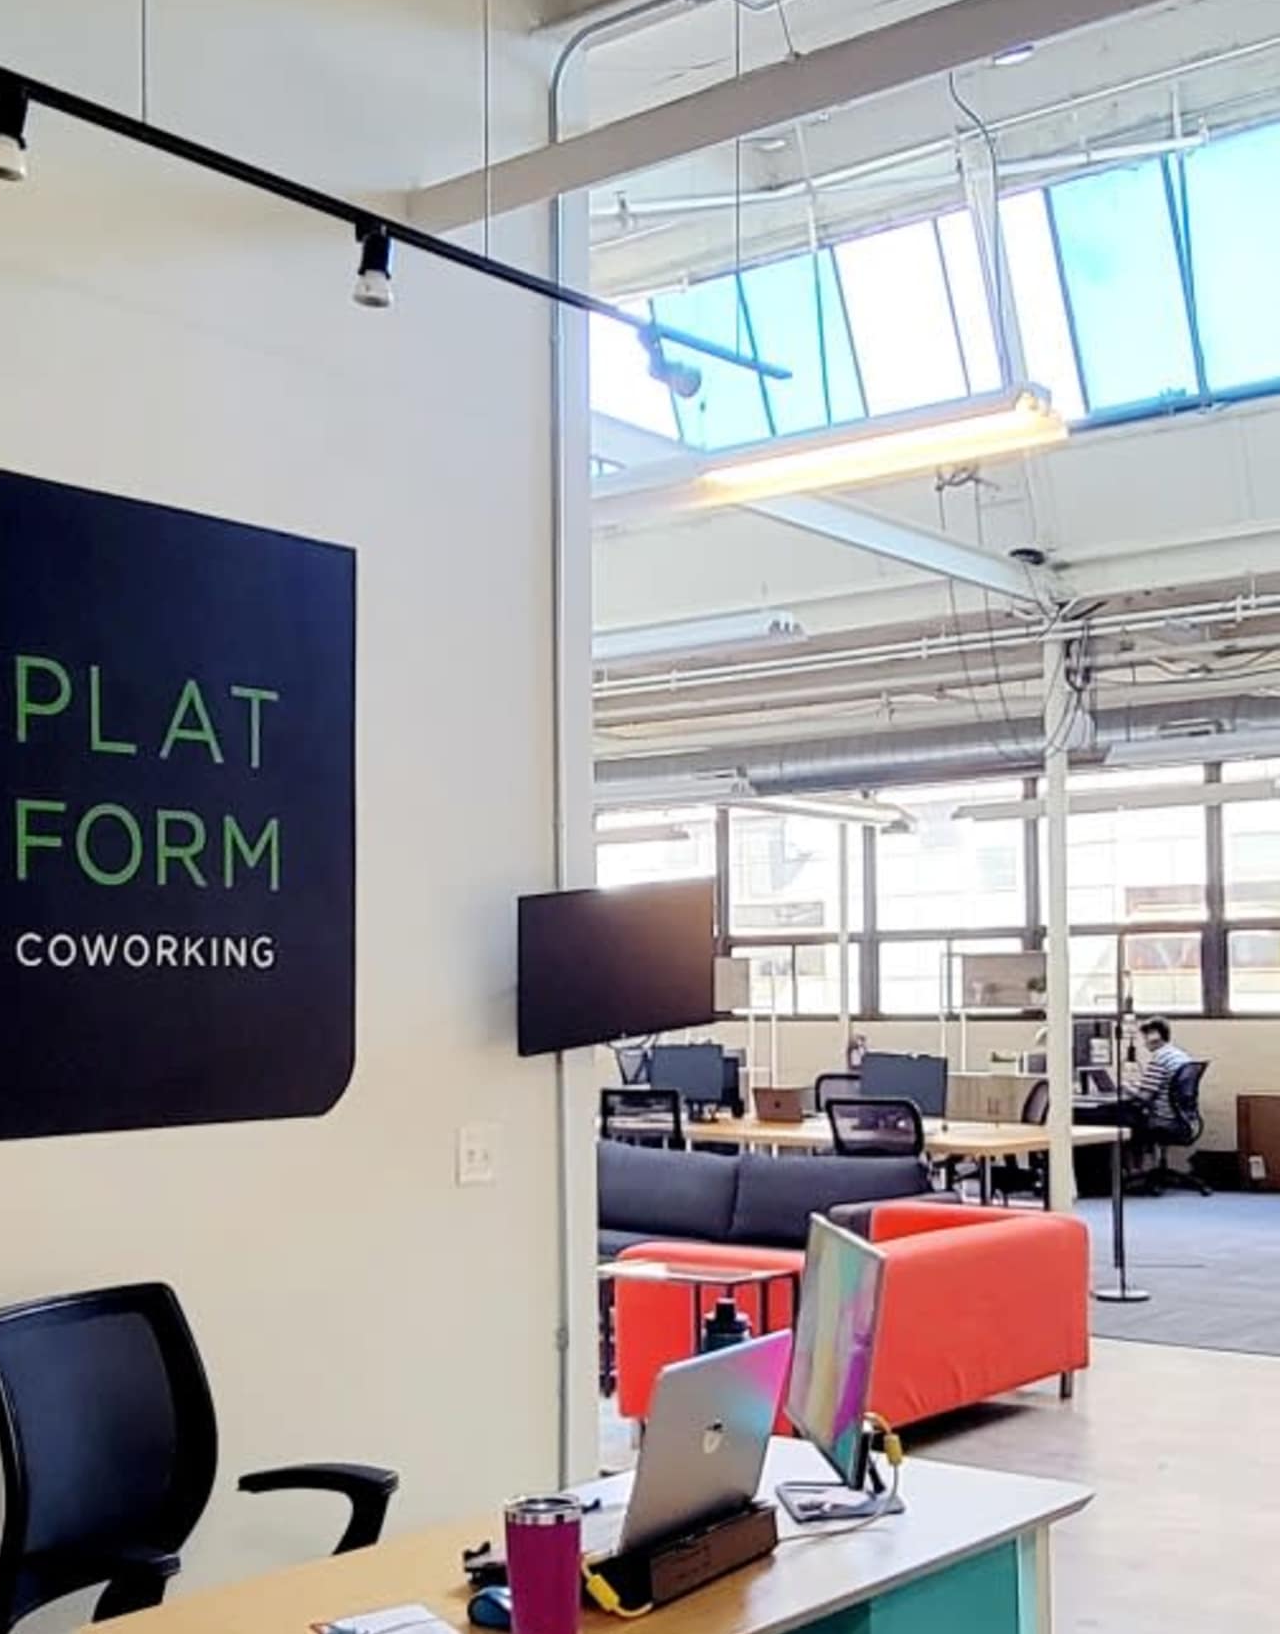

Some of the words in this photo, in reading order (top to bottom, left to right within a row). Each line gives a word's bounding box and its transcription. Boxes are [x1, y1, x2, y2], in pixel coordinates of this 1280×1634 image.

[15, 655, 279, 769] PLAT
[15, 798, 280, 892] FORM
[15, 930, 275, 969] COWORKING
